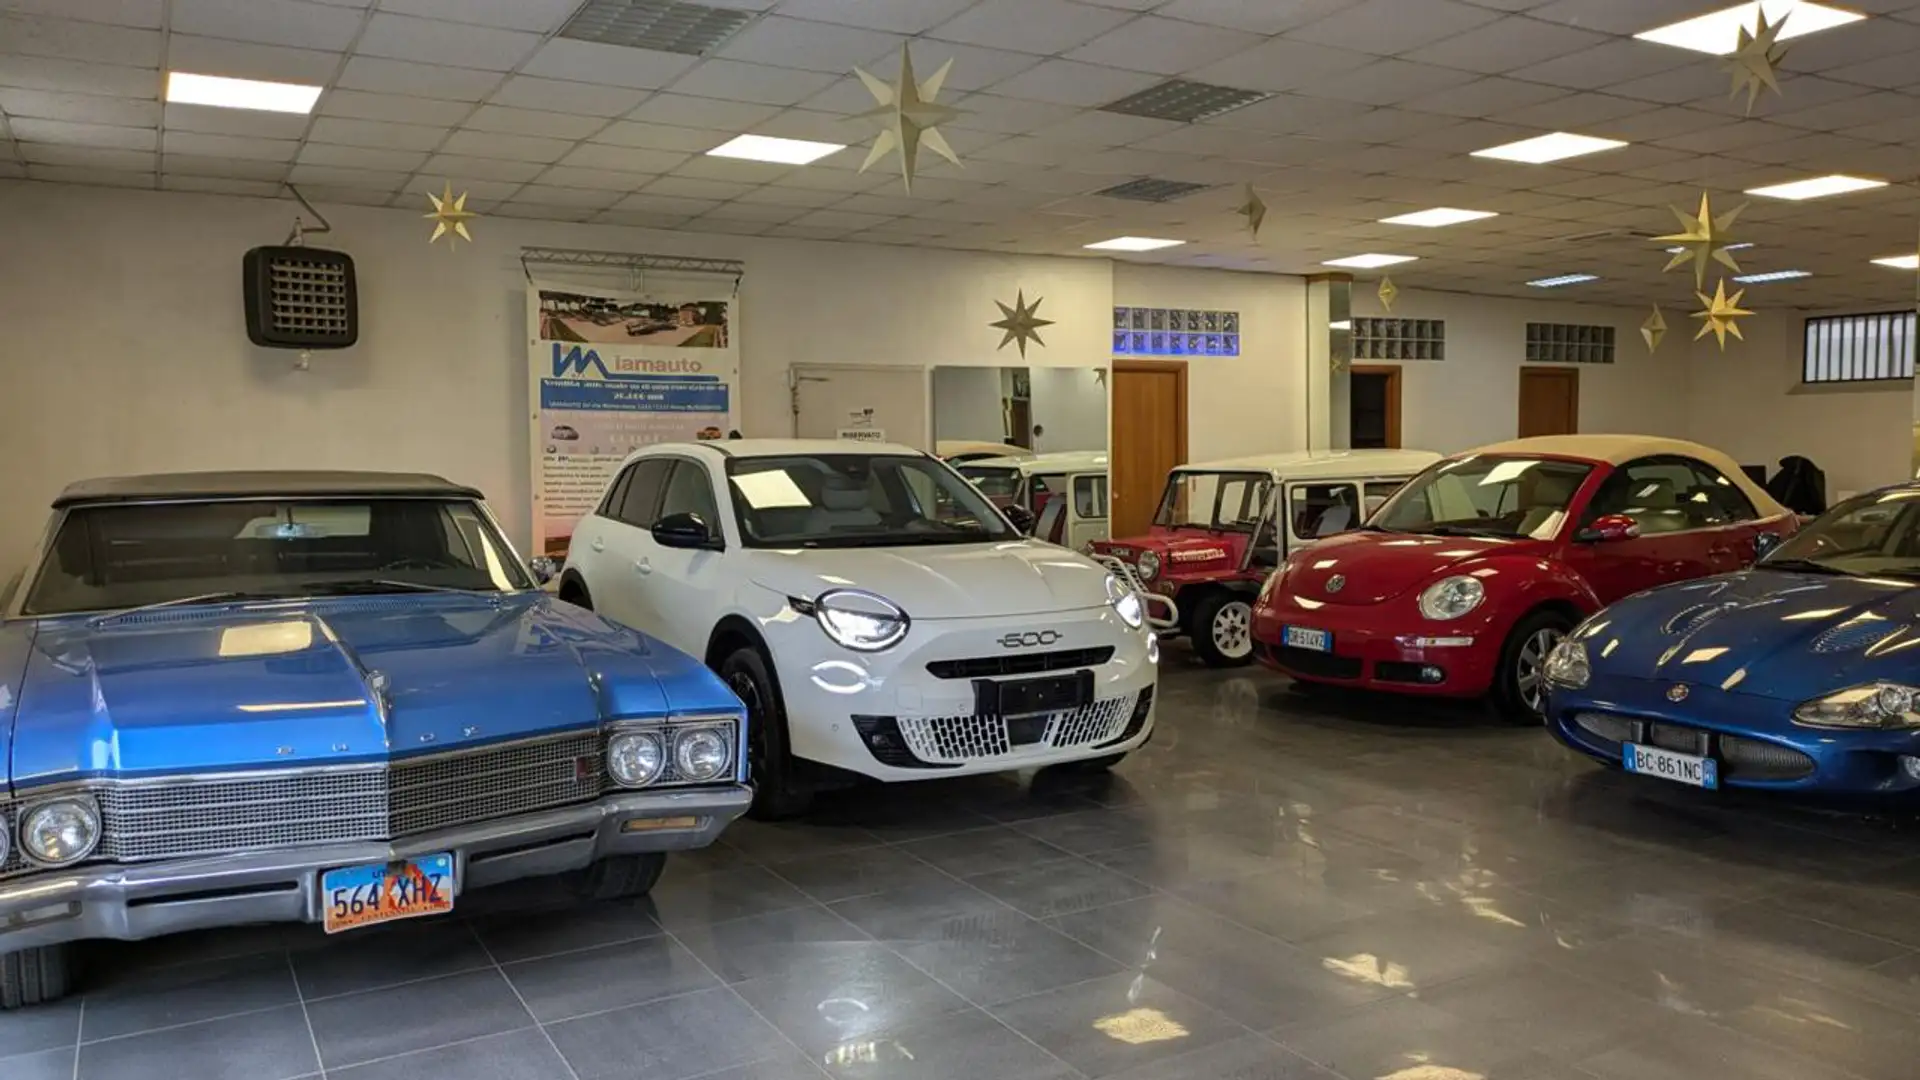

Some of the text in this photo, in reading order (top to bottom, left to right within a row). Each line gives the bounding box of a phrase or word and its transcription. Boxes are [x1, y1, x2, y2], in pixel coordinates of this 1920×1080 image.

[614, 355, 703, 373] iamauto
[334, 873, 443, 918] 564 XHZ
